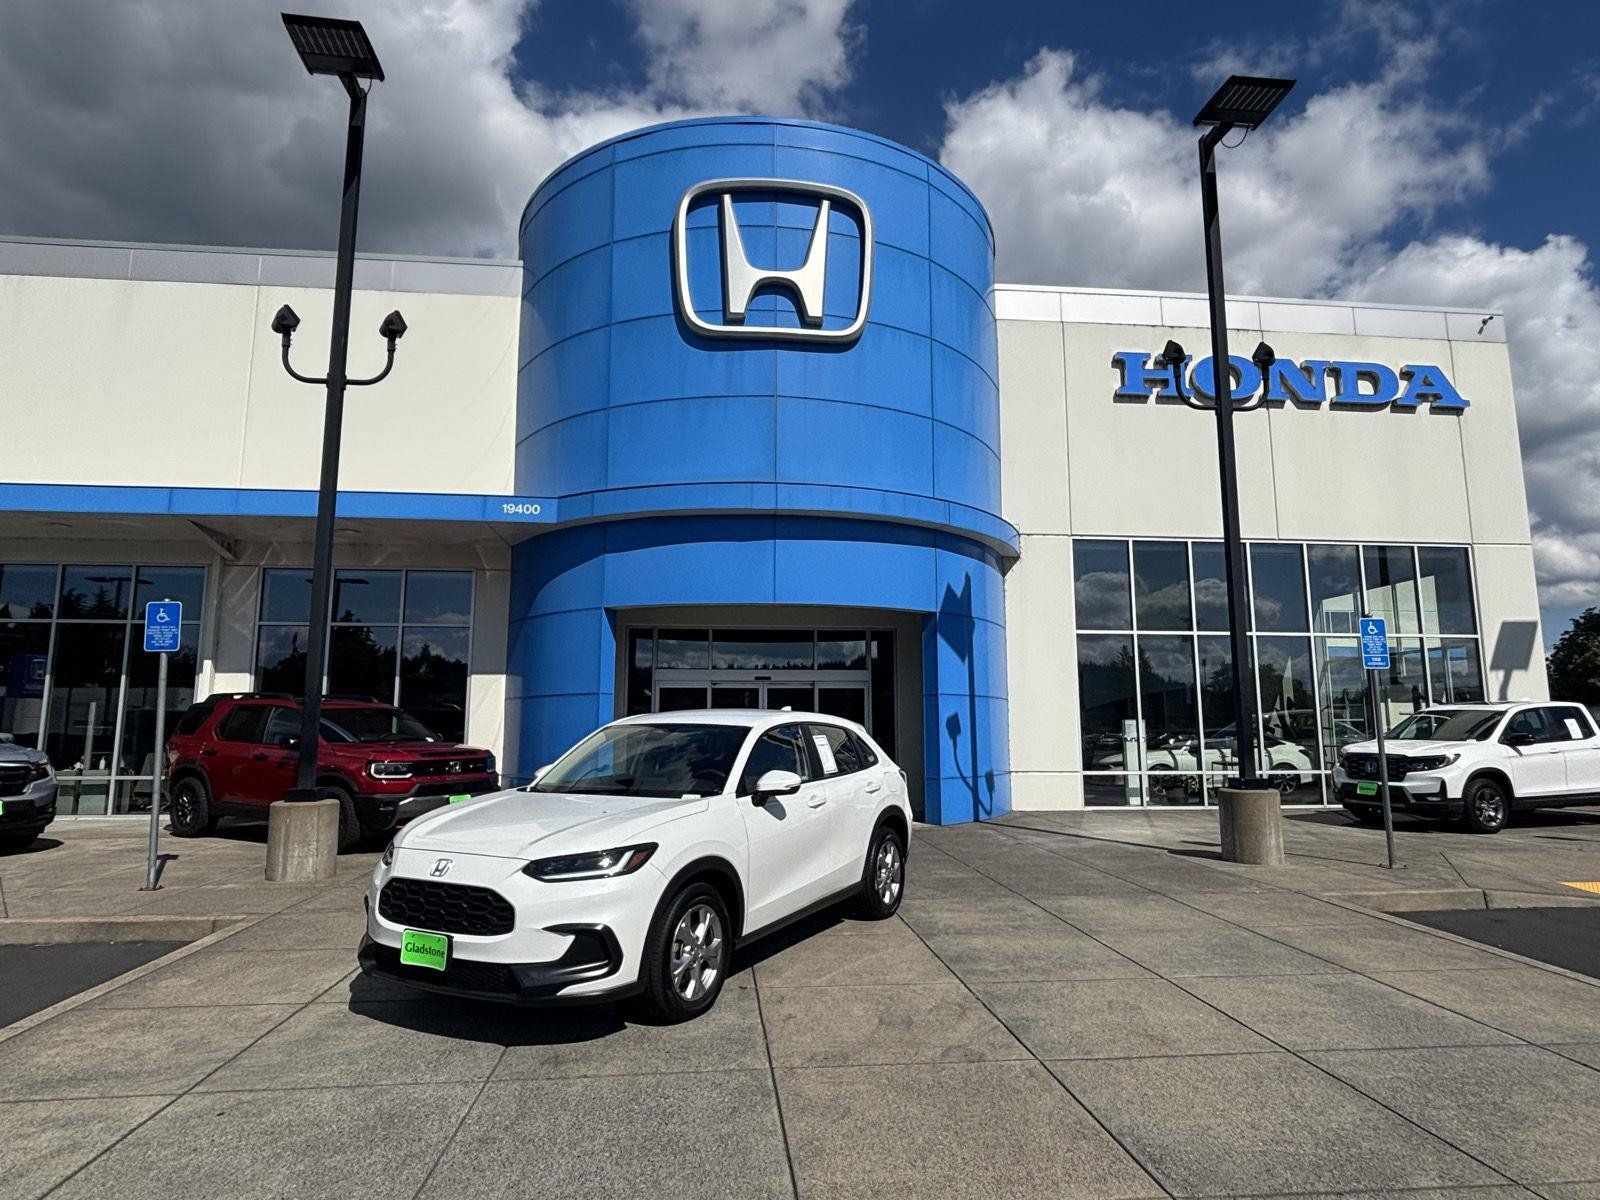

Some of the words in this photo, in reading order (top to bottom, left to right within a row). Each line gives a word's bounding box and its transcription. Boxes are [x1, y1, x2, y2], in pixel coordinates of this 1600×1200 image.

[1112, 351, 1471, 416] HONDA
[502, 503, 541, 515] 19400
[404, 941, 446, 959] Gladstone
